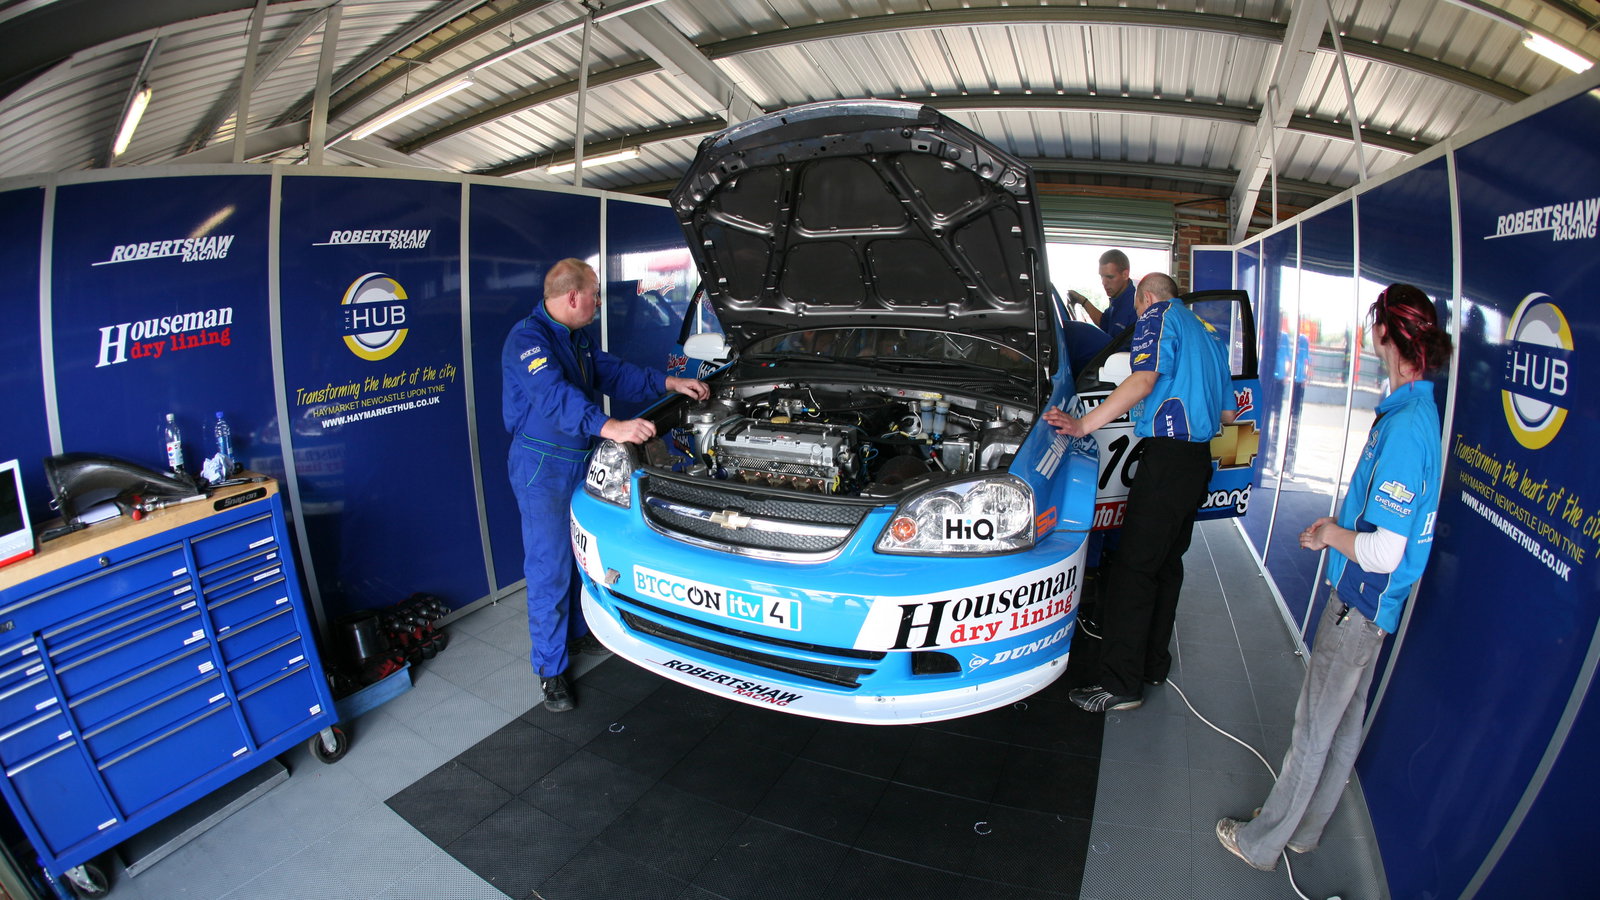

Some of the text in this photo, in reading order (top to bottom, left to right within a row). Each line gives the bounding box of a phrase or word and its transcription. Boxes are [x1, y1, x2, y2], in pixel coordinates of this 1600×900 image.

[1497, 197, 1600, 235] ROBERTSHAW
[1553, 222, 1597, 241] RACING
[111, 235, 234, 262] ROBERTSHAW
[329, 230, 431, 244] ROBERTSHAW
[389, 241, 426, 249] RACING
[182, 248, 228, 262] RACING
[353, 305, 406, 329] HUB
[95, 306, 233, 368] Houseman
[131, 327, 231, 358] dry lining
[296, 363, 457, 406] Transforming the heart of the city
[1512, 351, 1569, 396] HUB
[313, 384, 446, 418] HAYMARKET NEWCASTLE UPON TYNE
[321, 396, 440, 428] WWW.HAYMARKETHUB.CO.UK
[589, 465, 606, 486] HiQ
[1454, 434, 1502, 486] Transforming
[1502, 460, 1519, 488] the
[1519, 468, 1548, 503] heart
[1547, 487, 1565, 516] of
[1562, 493, 1583, 528] the
[1374, 495, 1412, 515] CHEVROLET
[1459, 470, 1585, 565] HAYMARKET NEWCASTLE UPON TYNE
[946, 518, 994, 540] HiQ
[1461, 490, 1572, 582] WWW.HAYMARKETHUB.CO.UK
[729, 594, 760, 617] itv
[888, 564, 1077, 650] Houseman
[950, 591, 1073, 643] dry lining
[989, 620, 1073, 665] DUNLOP
[662, 659, 803, 703] ROBERTSHAW
[733, 688, 789, 707] RACING
